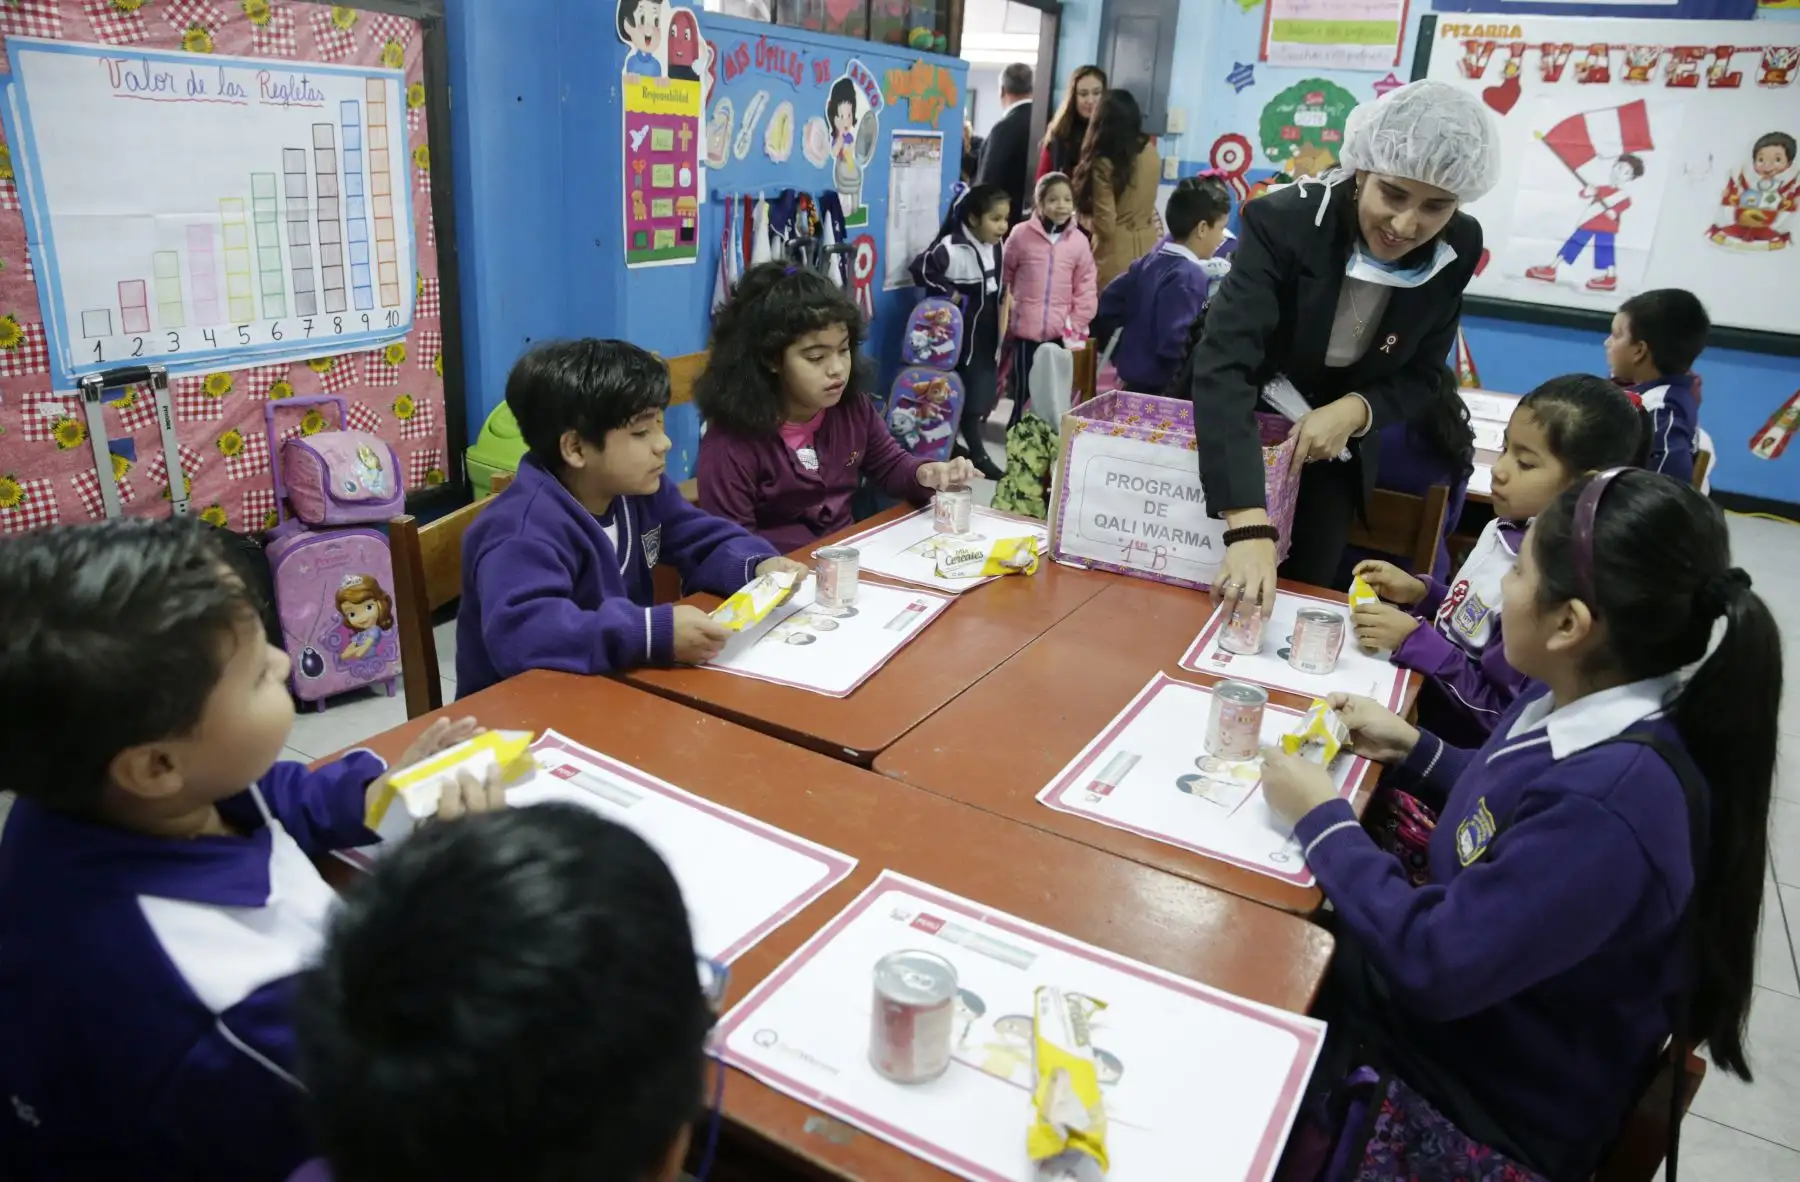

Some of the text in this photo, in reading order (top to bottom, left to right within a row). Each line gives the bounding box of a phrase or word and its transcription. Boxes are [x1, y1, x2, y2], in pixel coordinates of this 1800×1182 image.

[1441, 23, 1522, 39] PIZARRA
[812, 57, 831, 84] DE
[1457, 40, 1743, 88] VIVA EL
[99, 56, 325, 108] Valor de las Regletas
[642, 85, 689, 104] Responsabilidad
[94, 310, 399, 362] 1 2 3 4 5 6 7 8 9 10
[1143, 500, 1169, 518] DE
[1094, 514, 1213, 550] QALI WARMA
[945, 551, 984, 567] Cereales
[1145, 545, 1168, 571] B
